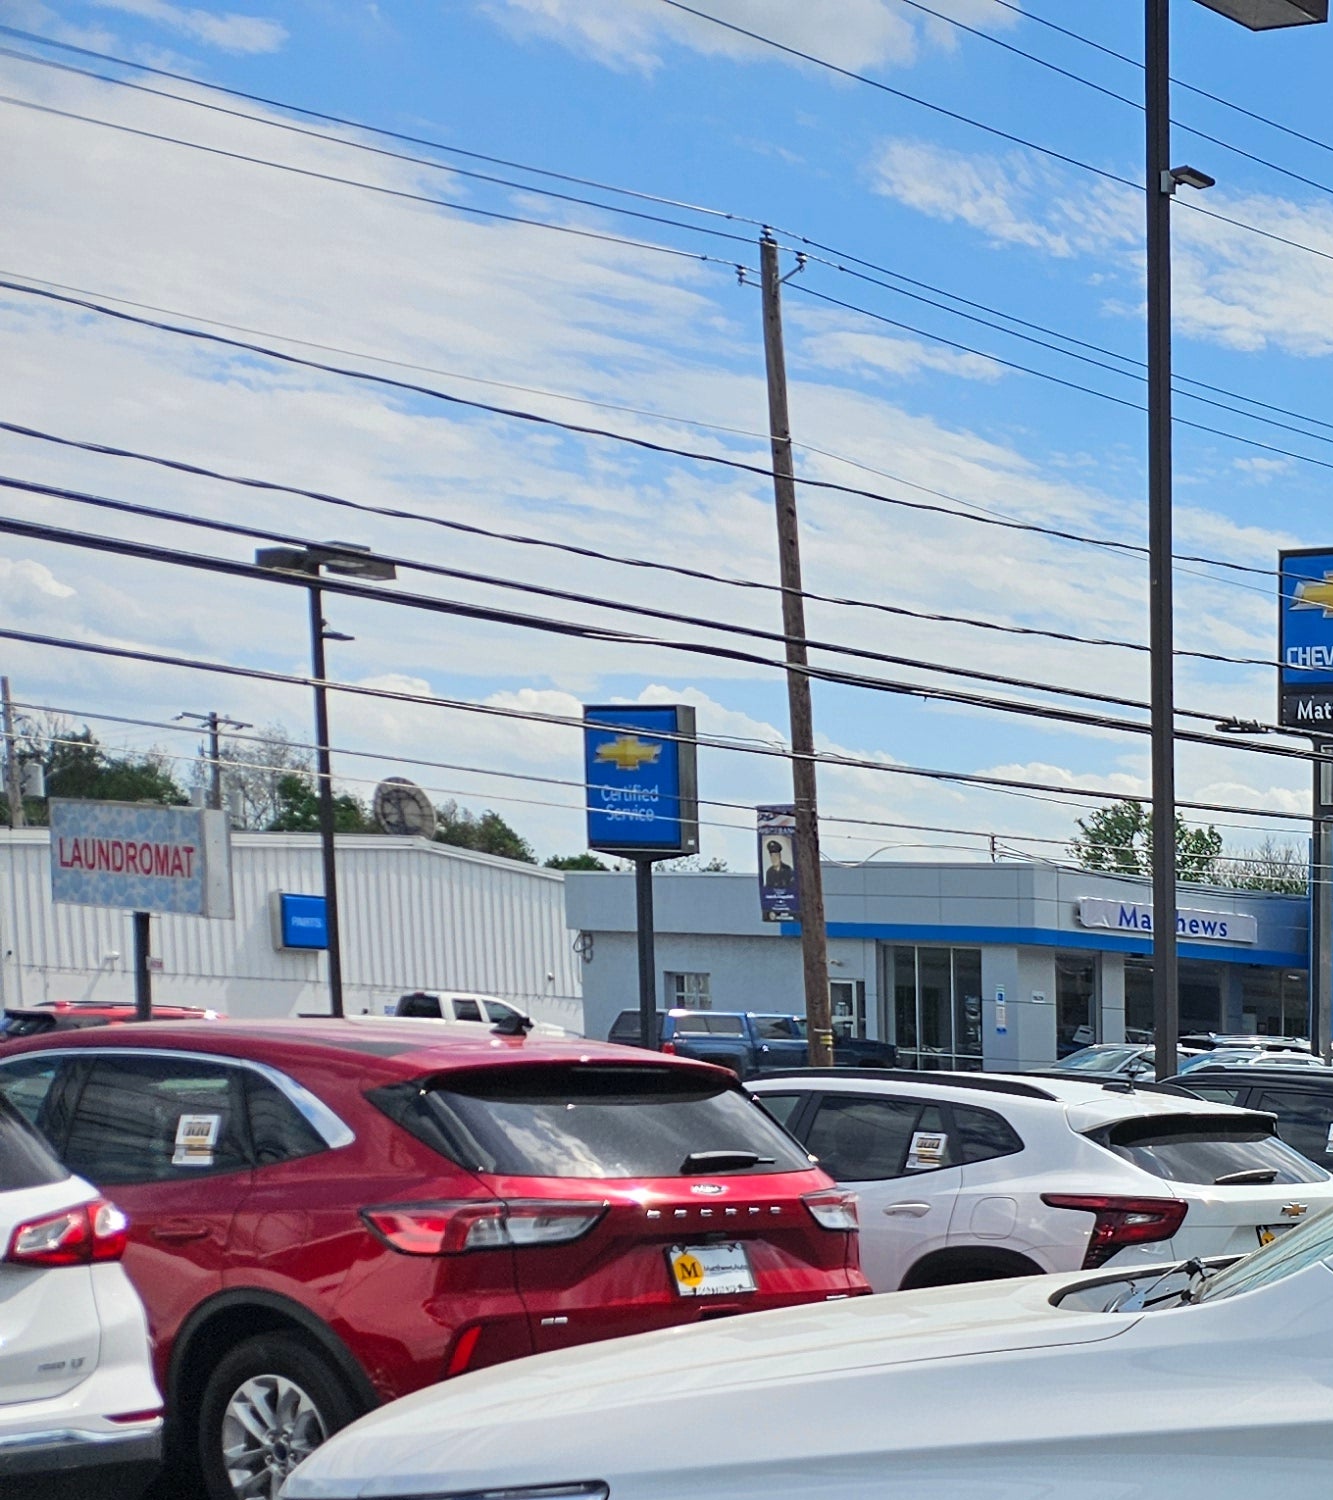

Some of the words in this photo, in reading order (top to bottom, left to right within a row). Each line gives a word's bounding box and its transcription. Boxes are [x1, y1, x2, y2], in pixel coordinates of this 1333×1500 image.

[601, 785, 660, 802] Certified
[59, 837, 195, 878] LAUNDROMAT
[1118, 905, 1228, 938] Mahews
